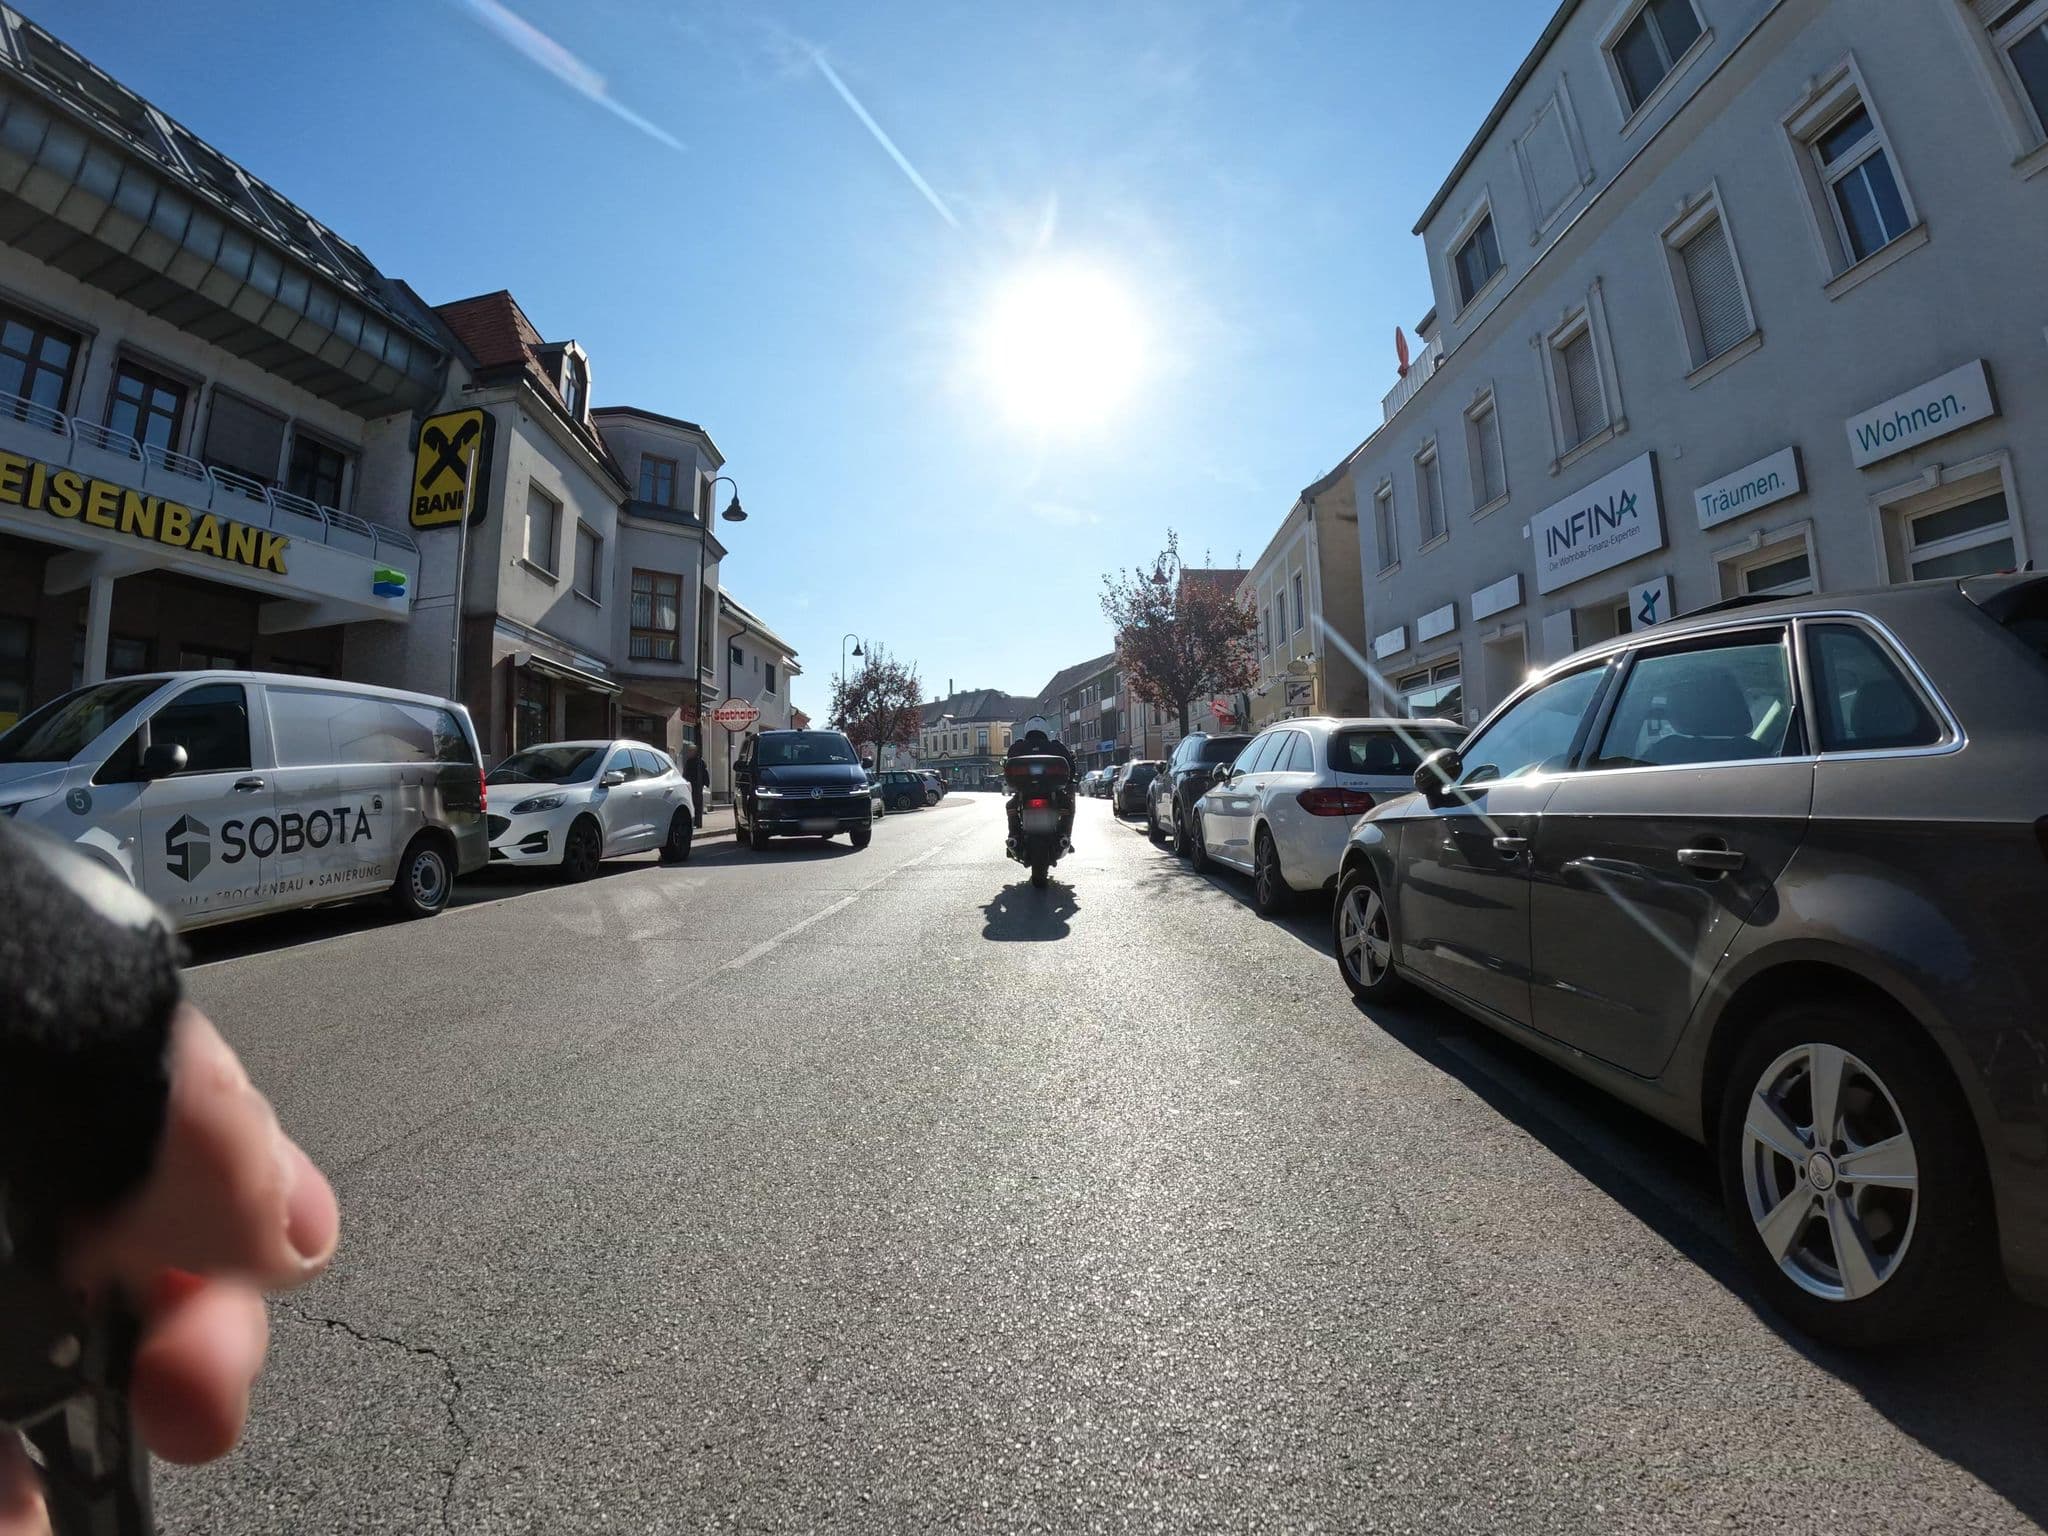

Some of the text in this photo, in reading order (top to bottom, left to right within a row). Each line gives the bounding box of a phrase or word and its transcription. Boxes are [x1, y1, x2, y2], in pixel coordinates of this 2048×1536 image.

[1856, 394, 1966, 452] Wohnen.
[0, 453, 289, 574] EISENBANK
[1547, 489, 1638, 557] INFINA
[1701, 471, 1785, 517] Träumen.
[74, 792, 85, 809] 5
[221, 805, 373, 864] SOBOTA
[319, 865, 383, 887] SANIERUNG
